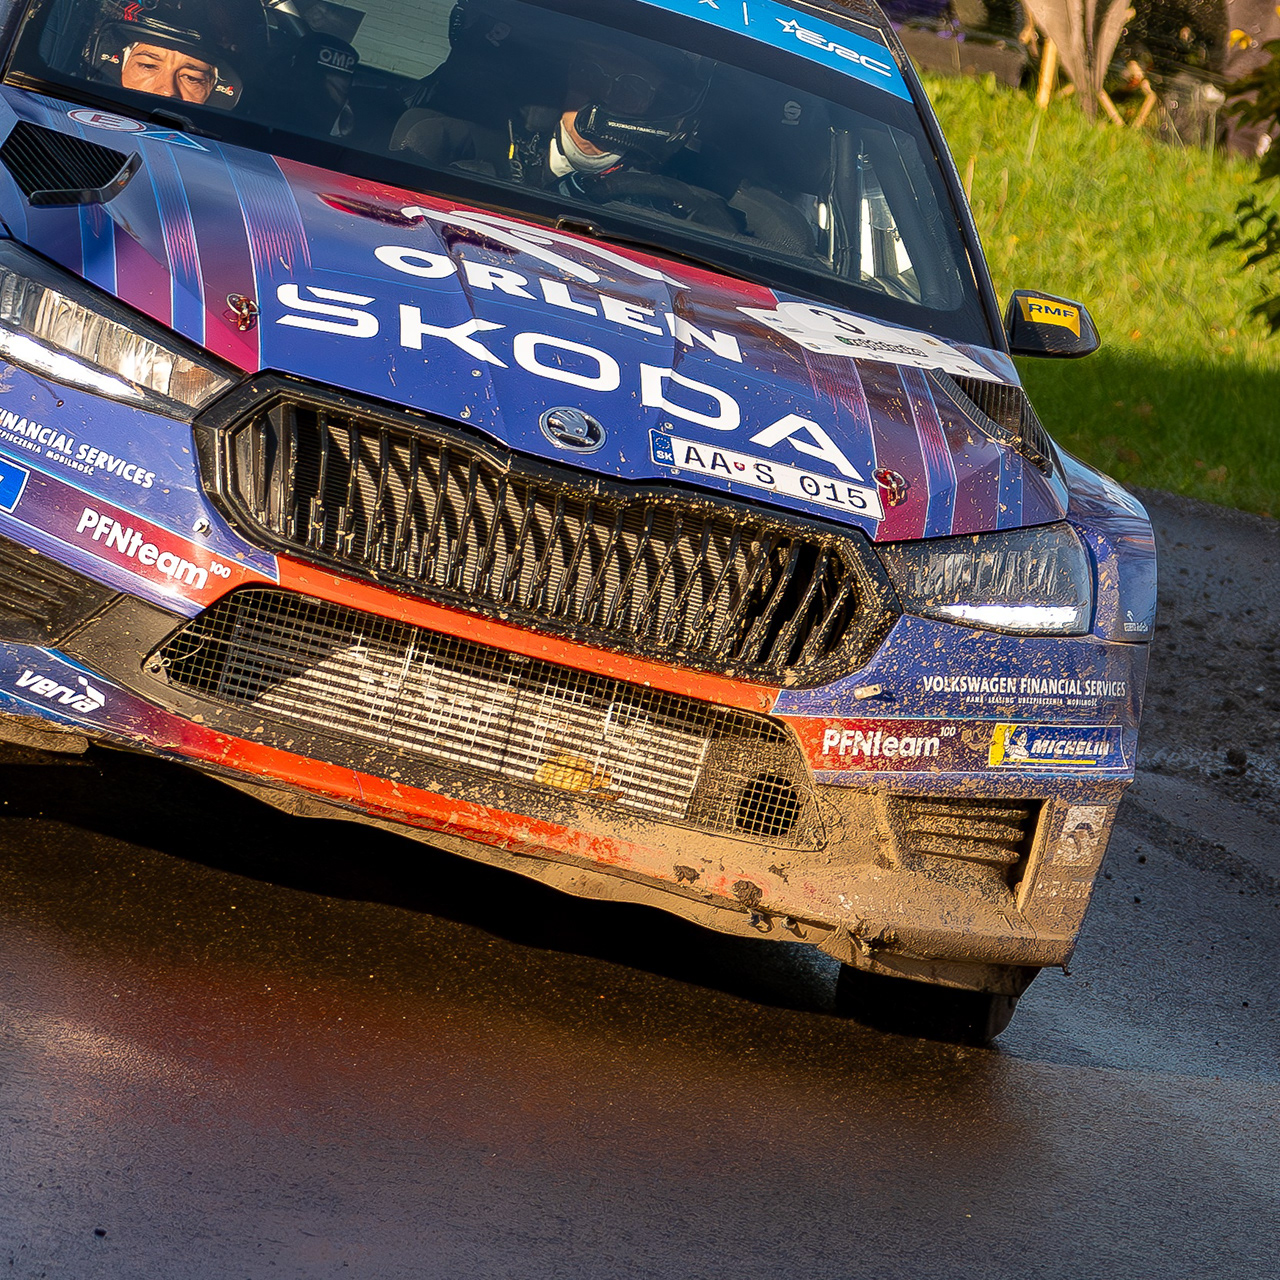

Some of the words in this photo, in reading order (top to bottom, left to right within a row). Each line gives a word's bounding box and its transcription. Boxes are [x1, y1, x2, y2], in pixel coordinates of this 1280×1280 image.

[320, 48, 355, 69] OMP
[375, 245, 744, 363] ORLEN
[1029, 303, 1074, 317] RMF
[808, 308, 866, 335] 3
[275, 282, 866, 482] SKODA
[76, 444, 157, 490] SERVICES
[656, 450, 673, 461] SK
[684, 445, 733, 475] AA
[799, 475, 867, 510] 015
[76, 507, 209, 590] PFNteam
[208, 560, 232, 579] 100
[15, 669, 106, 713] verva
[923, 675, 1017, 694] VOLKSWAGEN
[1020, 678, 1082, 696] FINANCIAL
[1084, 680, 1126, 697] SERVICES
[822, 729, 940, 757] PFNteam
[1031, 739, 1111, 757] MICHELIN
